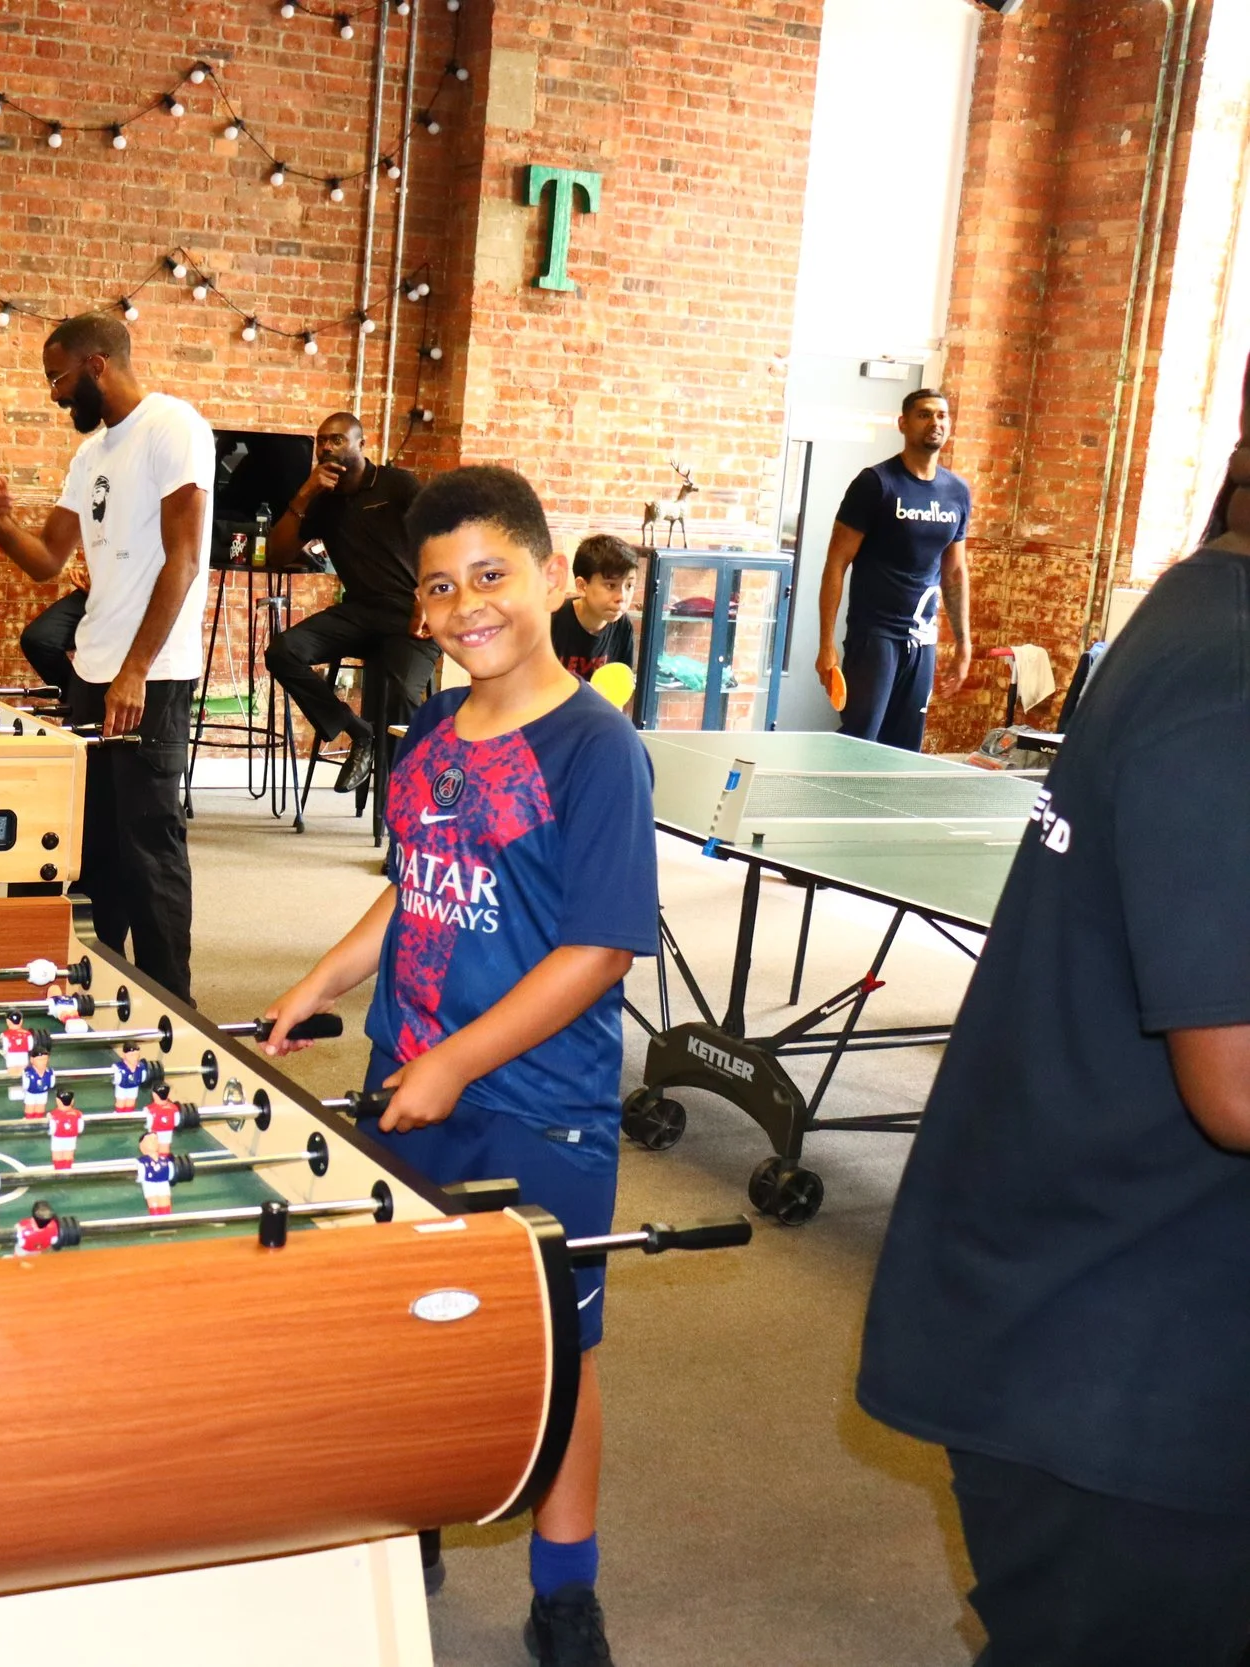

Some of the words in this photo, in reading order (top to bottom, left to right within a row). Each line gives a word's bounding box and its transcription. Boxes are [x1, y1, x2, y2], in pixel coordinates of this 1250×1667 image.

[524, 165, 602, 292] T
[401, 887, 500, 934] AIRWAYS
[687, 1035, 755, 1082] KETTLER
